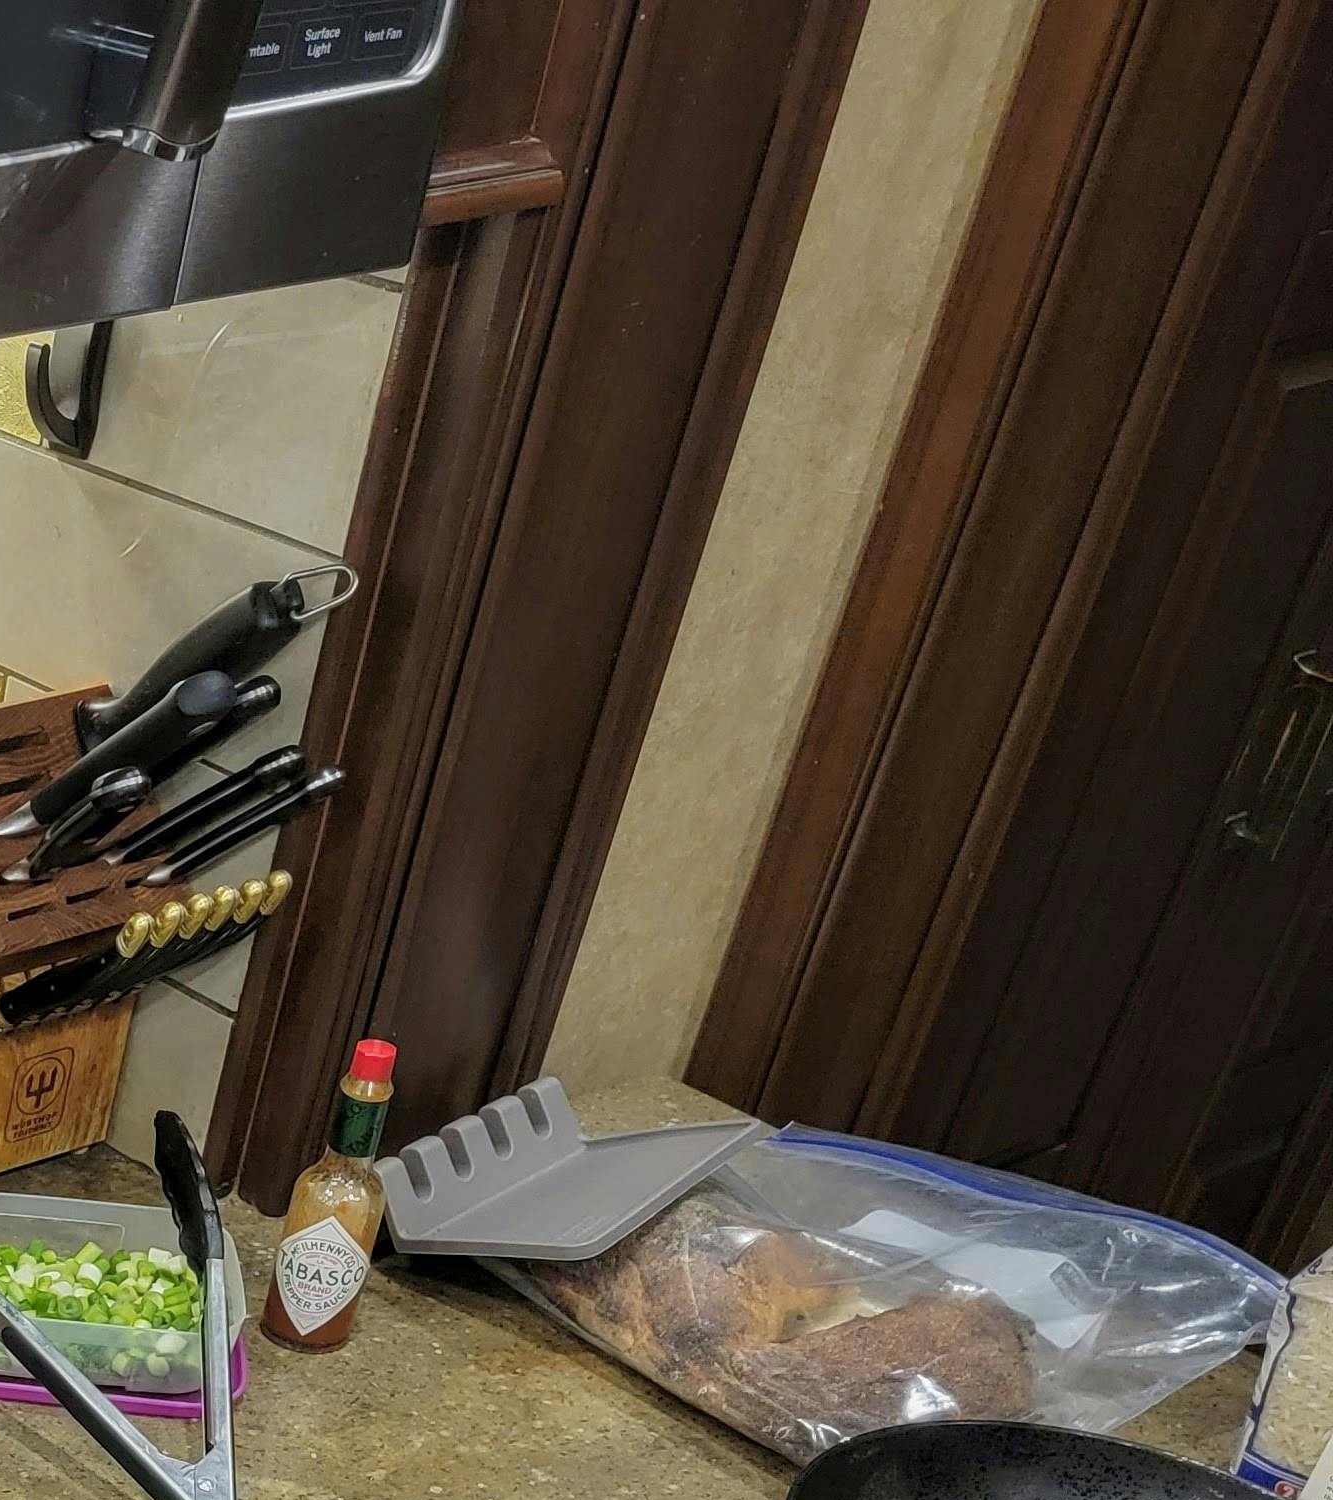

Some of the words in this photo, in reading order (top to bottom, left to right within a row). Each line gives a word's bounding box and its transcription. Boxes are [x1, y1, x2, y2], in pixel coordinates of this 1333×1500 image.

[304, 26, 342, 42] Surface
[364, 29, 385, 43] Vent
[385, 27, 404, 40] Fan
[306, 42, 333, 59] Light
[280, 1248, 365, 1287] TABASCO
[283, 1274, 312, 1310] PEPPER
[314, 1287, 350, 1311] SAUCE
[297, 1281, 332, 1295] BRAND
